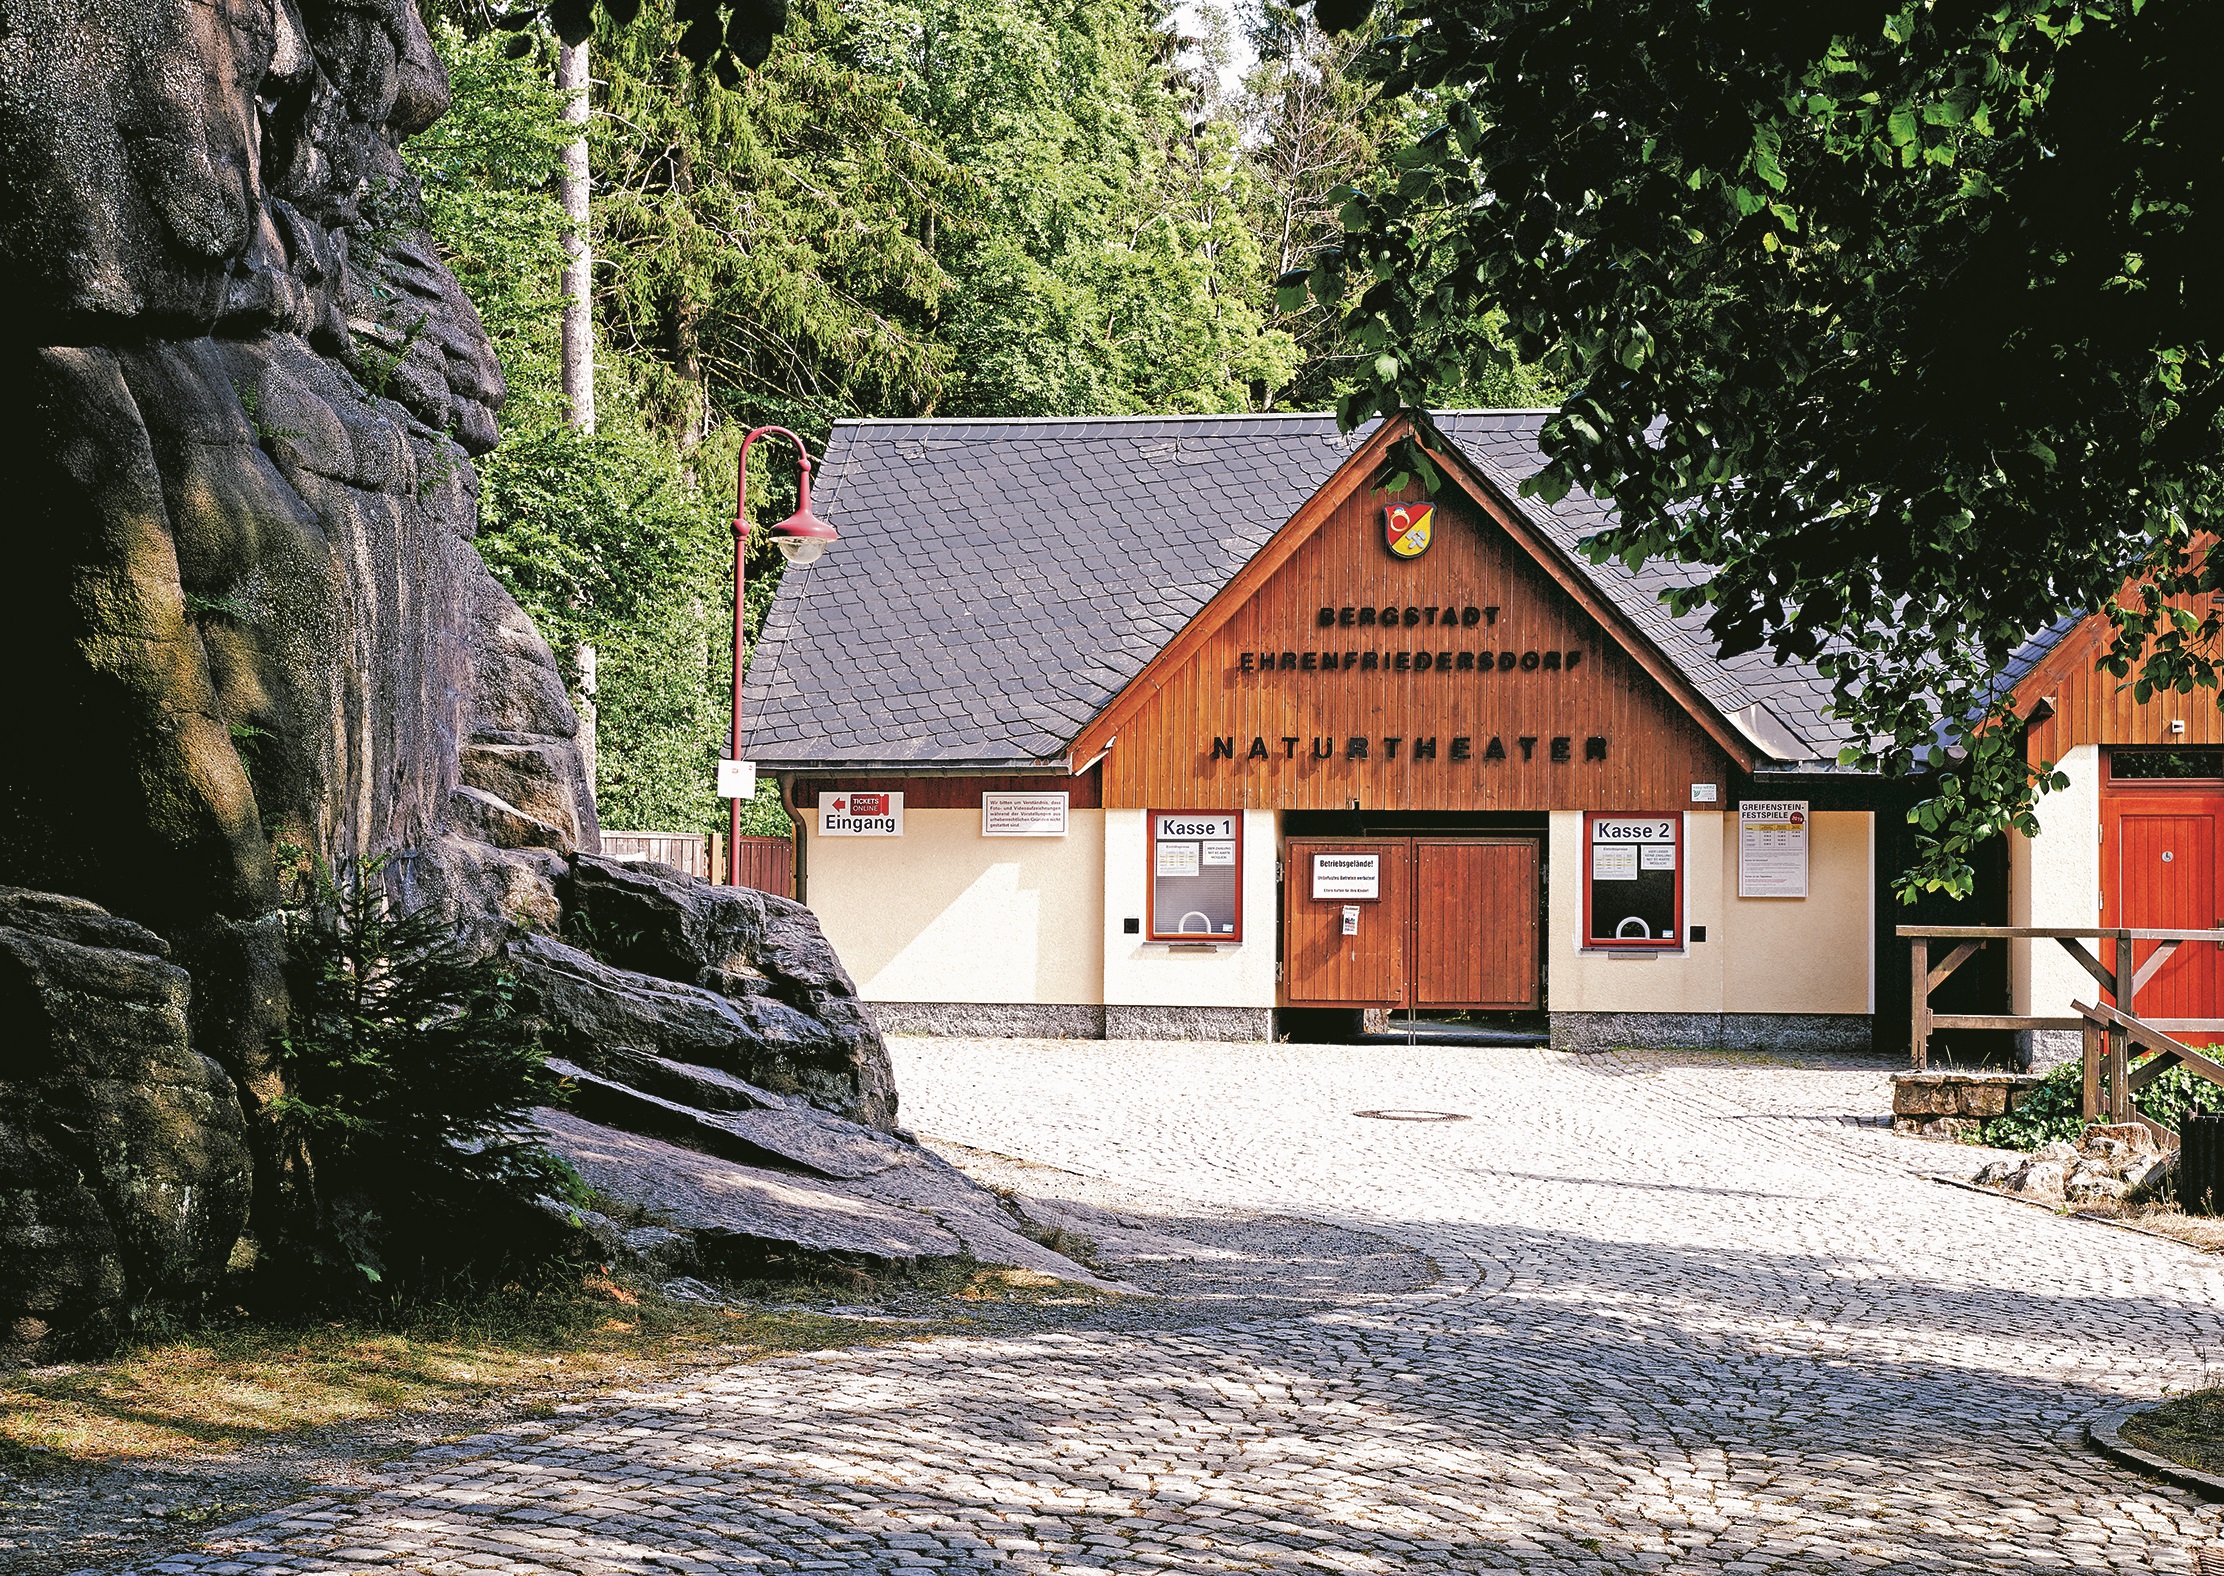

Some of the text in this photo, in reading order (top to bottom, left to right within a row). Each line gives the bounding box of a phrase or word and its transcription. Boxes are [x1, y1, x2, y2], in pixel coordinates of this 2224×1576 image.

[1319, 606, 1500, 627] BERGSTADT
[1239, 651, 1582, 671] EHRENFRIEDERSDORF
[1212, 736, 1607, 760] NATURTHEATER
[1741, 803, 1804, 811] GREIFENSTEIN-
[1741, 811, 1788, 819] FESTSPIELE
[826, 814, 895, 833] Eingang
[1163, 819, 1230, 835] Kasse 1
[1598, 822, 1670, 838] Kasse 2
[1320, 859, 1374, 868] Betriebsgelände!
